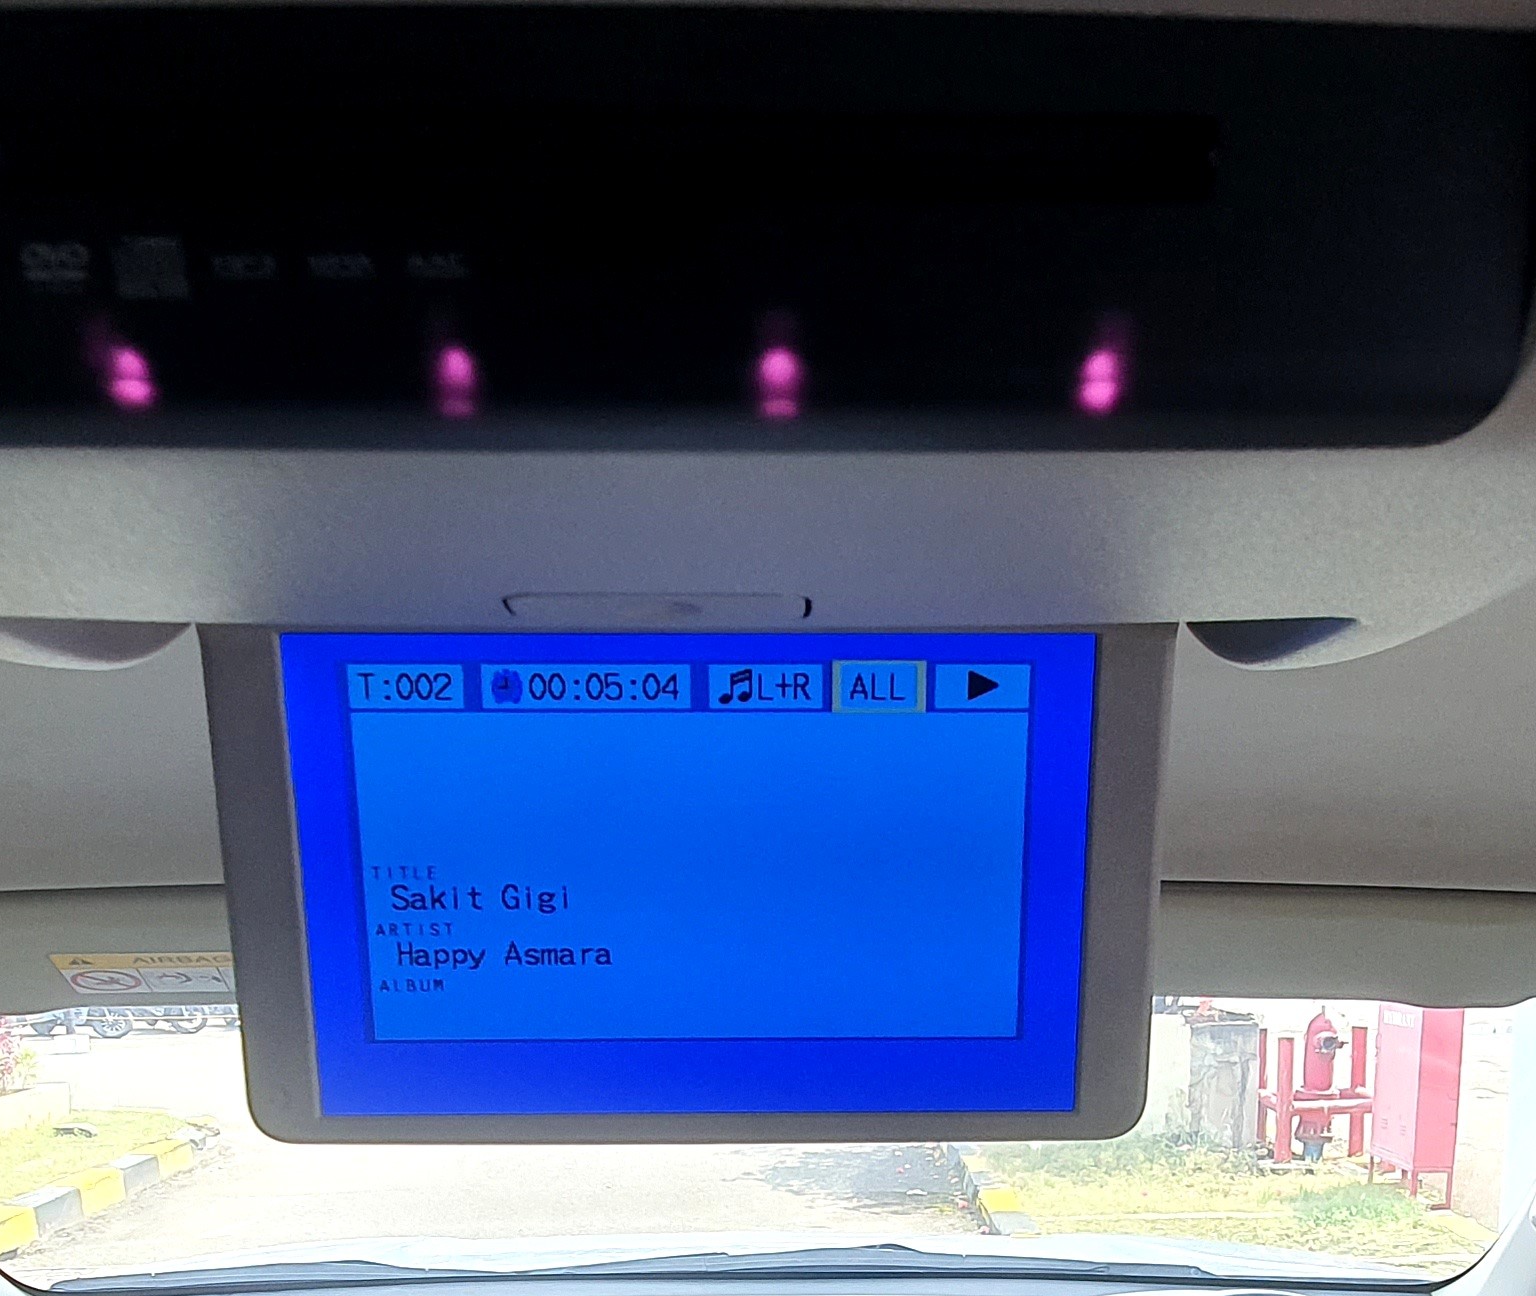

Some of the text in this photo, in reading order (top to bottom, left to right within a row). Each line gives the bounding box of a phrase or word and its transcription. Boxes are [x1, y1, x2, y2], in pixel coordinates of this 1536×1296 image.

[356, 672, 453, 701] T:002
[528, 672, 680, 701] 00:05:04
[757, 672, 812, 701] L+R
[849, 672, 907, 701] ALL
[370, 865, 437, 881] TITLE
[390, 883, 570, 914] Sakit Gigi
[374, 922, 454, 937] ARTIST
[396, 940, 613, 970] Happy Asmara
[378, 978, 446, 993] ALBUM
